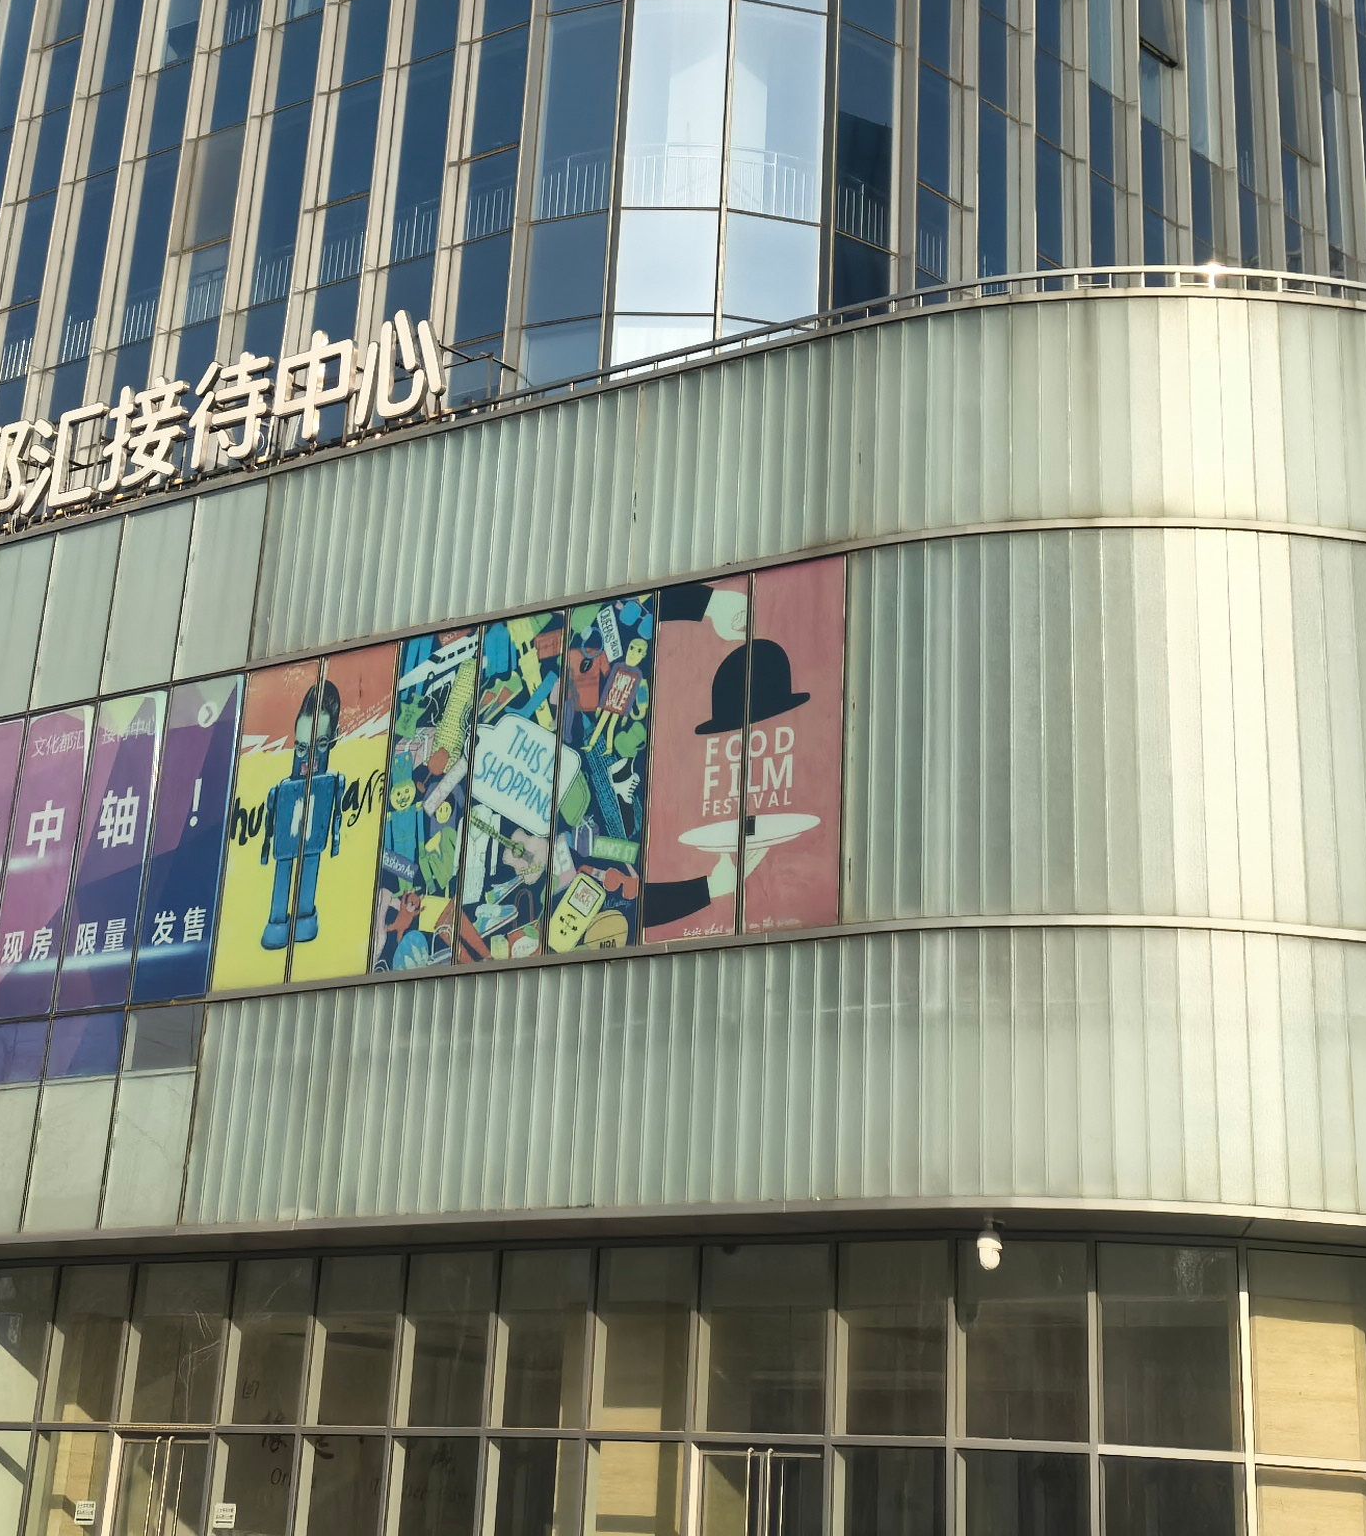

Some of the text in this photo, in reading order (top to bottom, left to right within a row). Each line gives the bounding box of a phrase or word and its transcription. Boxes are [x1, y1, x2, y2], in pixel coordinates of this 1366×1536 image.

[507, 725, 547, 774] THIS
[705, 726, 795, 765] FOOD
[703, 754, 794, 801] FILM
[702, 789, 792, 817] FESVAL
